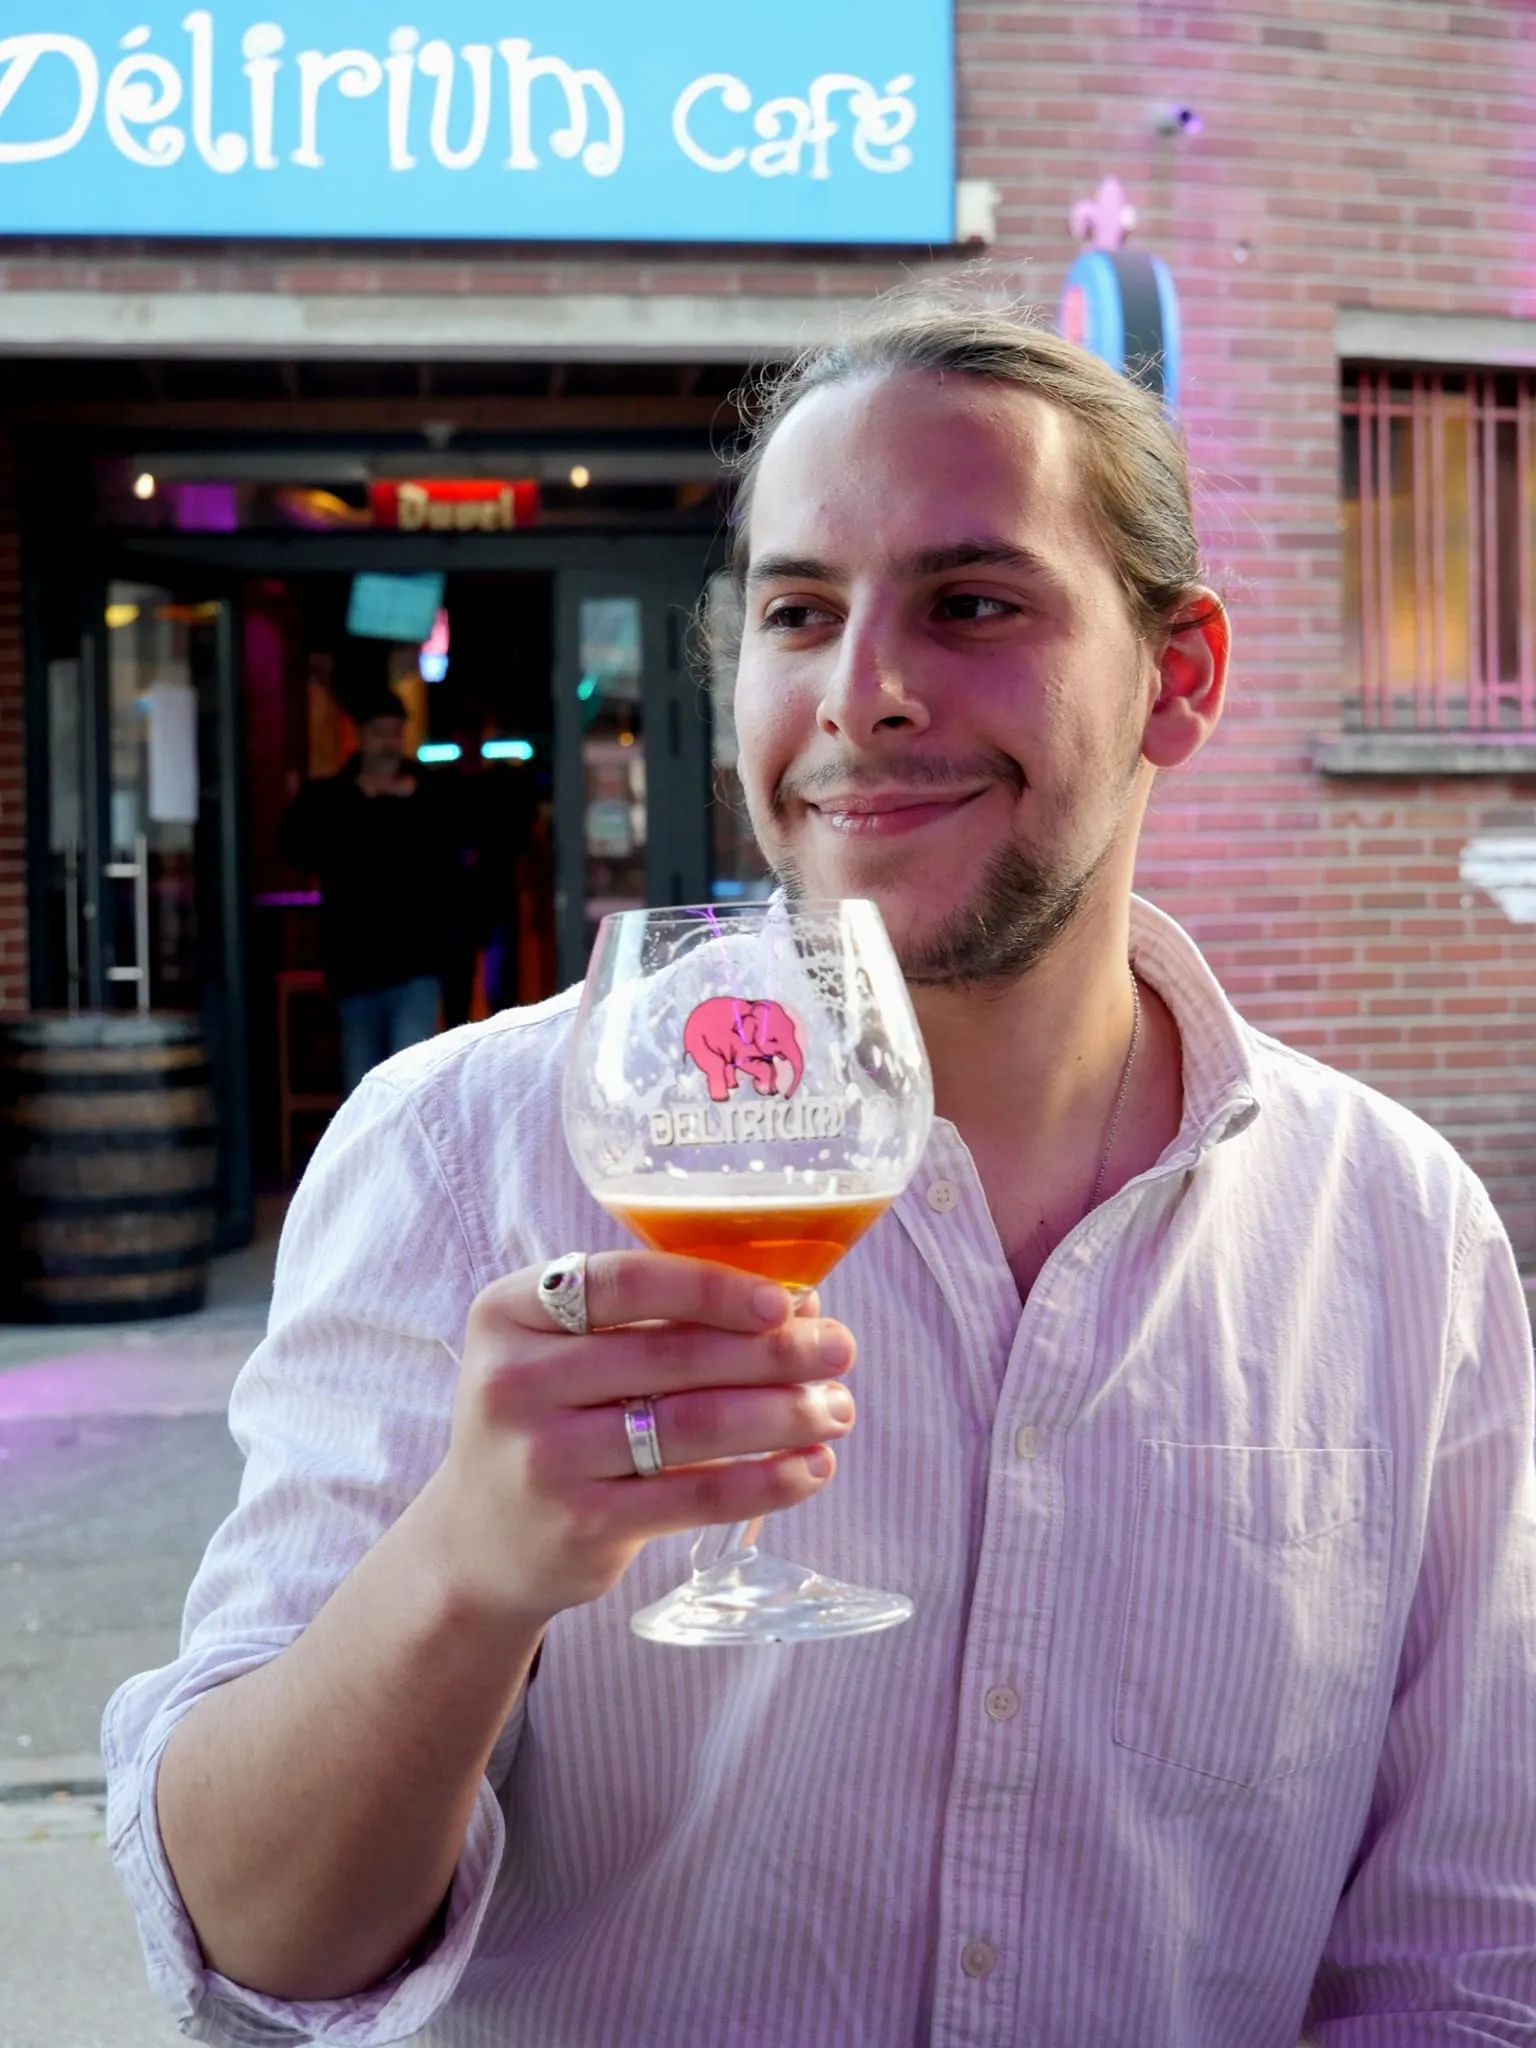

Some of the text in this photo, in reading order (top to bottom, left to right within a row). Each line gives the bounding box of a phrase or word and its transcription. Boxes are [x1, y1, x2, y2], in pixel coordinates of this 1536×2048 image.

[0, 11, 916, 179] Délirium Café
[650, 1101, 845, 1146] DELIRIUM
